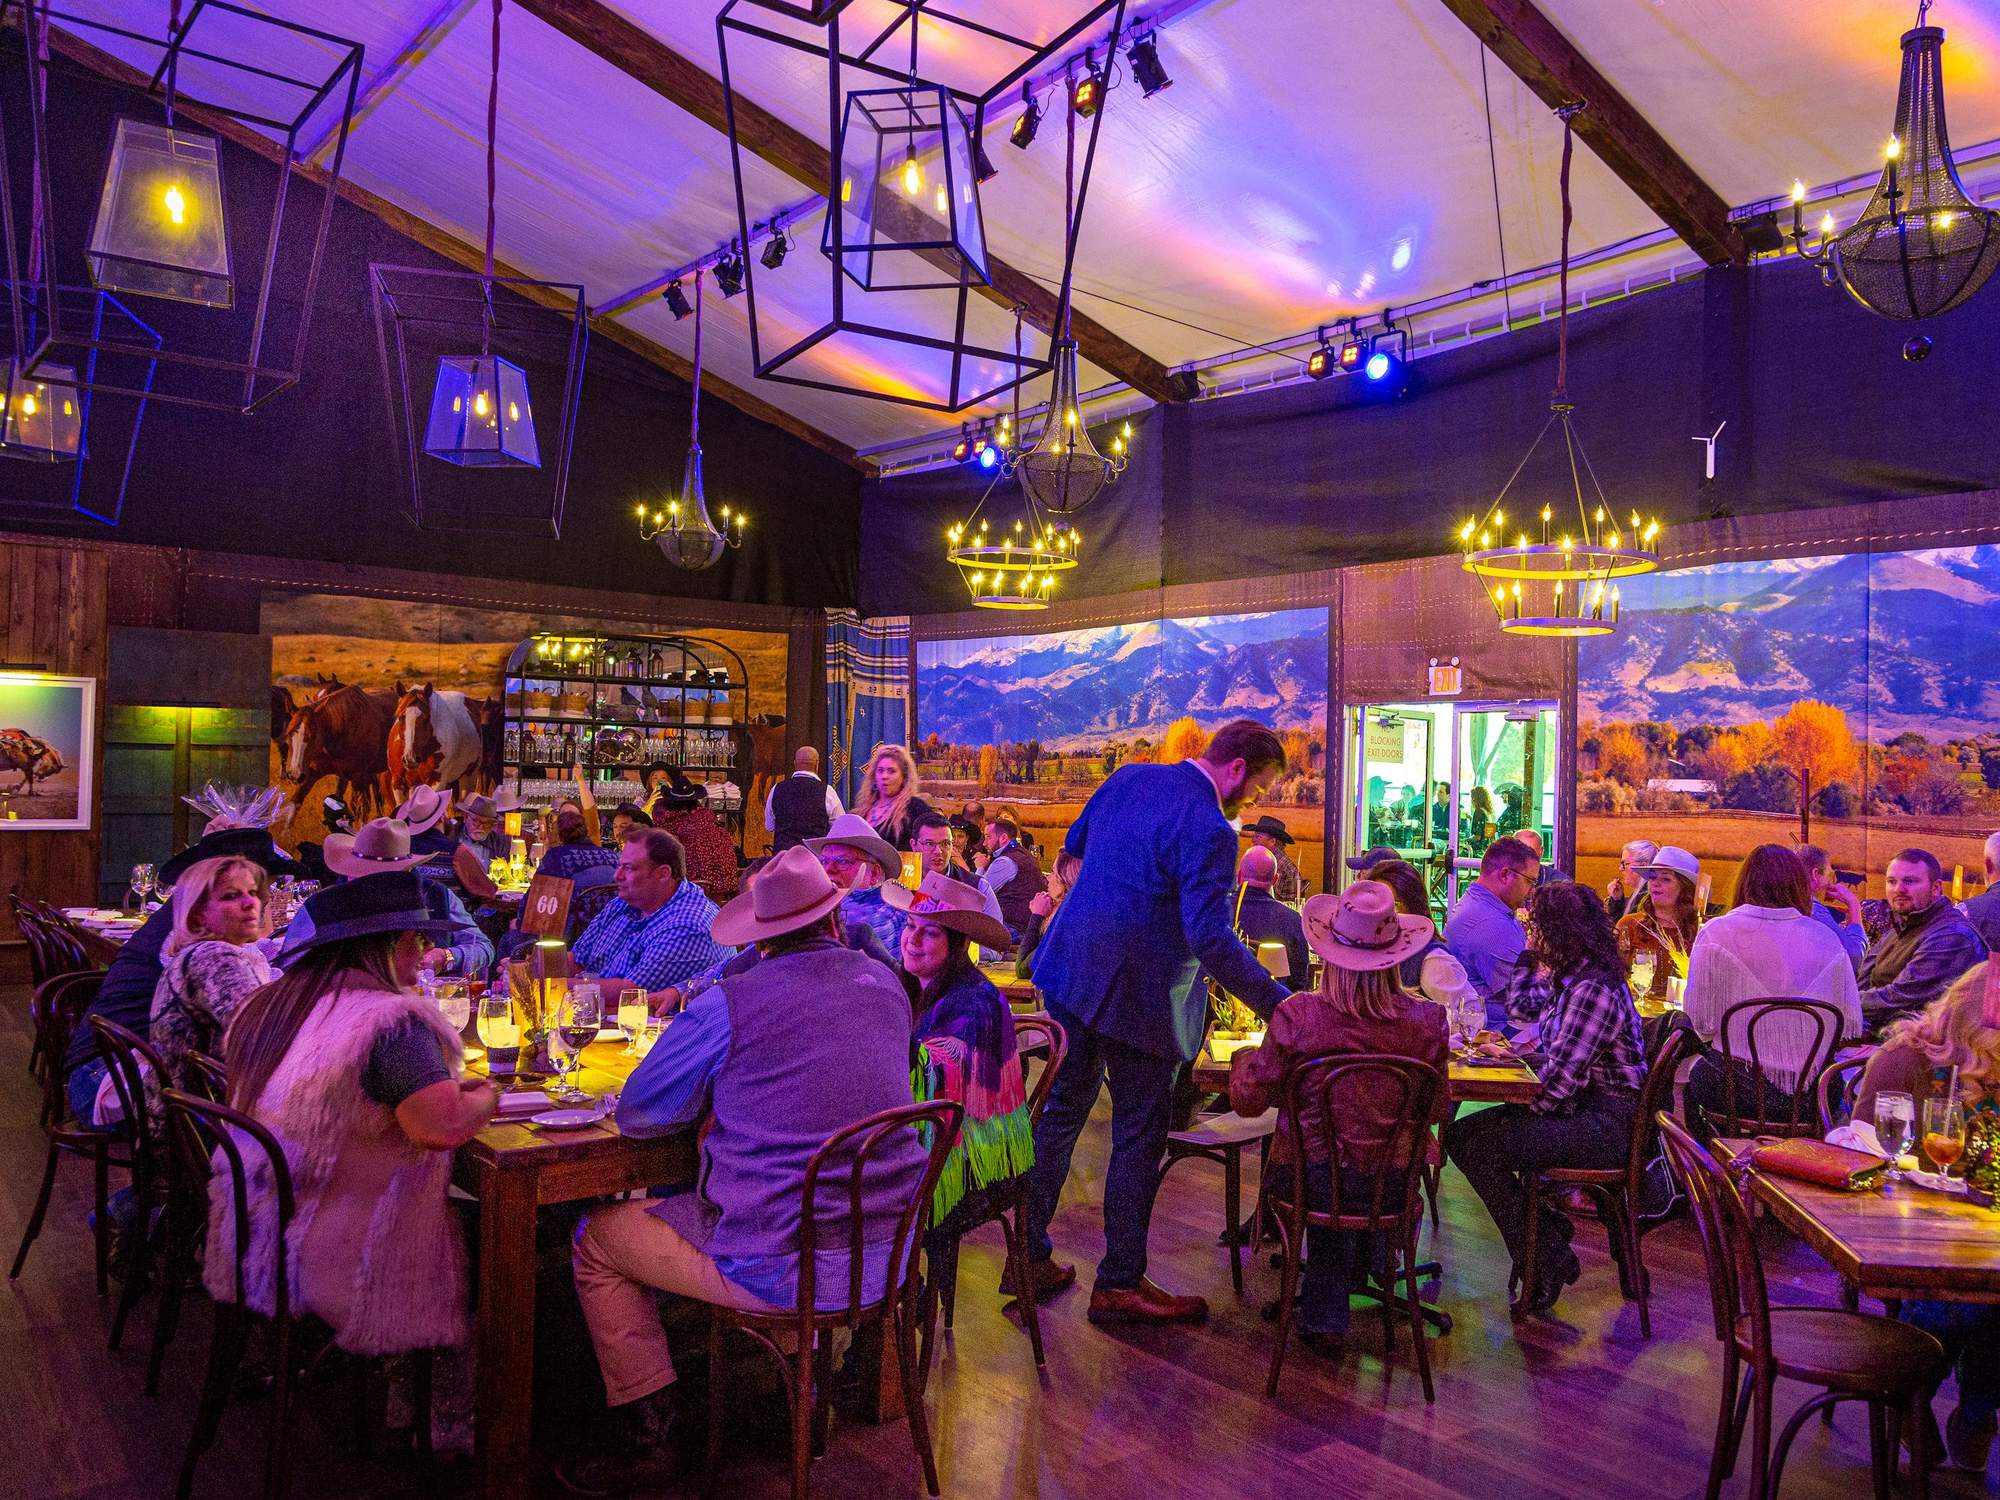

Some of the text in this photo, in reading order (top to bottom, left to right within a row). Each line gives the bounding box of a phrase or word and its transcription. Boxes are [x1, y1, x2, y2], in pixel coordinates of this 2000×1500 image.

[1434, 667, 1457, 692] EXIT
[1370, 735, 1401, 746] BLOCKING
[1368, 748, 1403, 760] EXIT DOORS
[537, 895, 558, 915] 60
